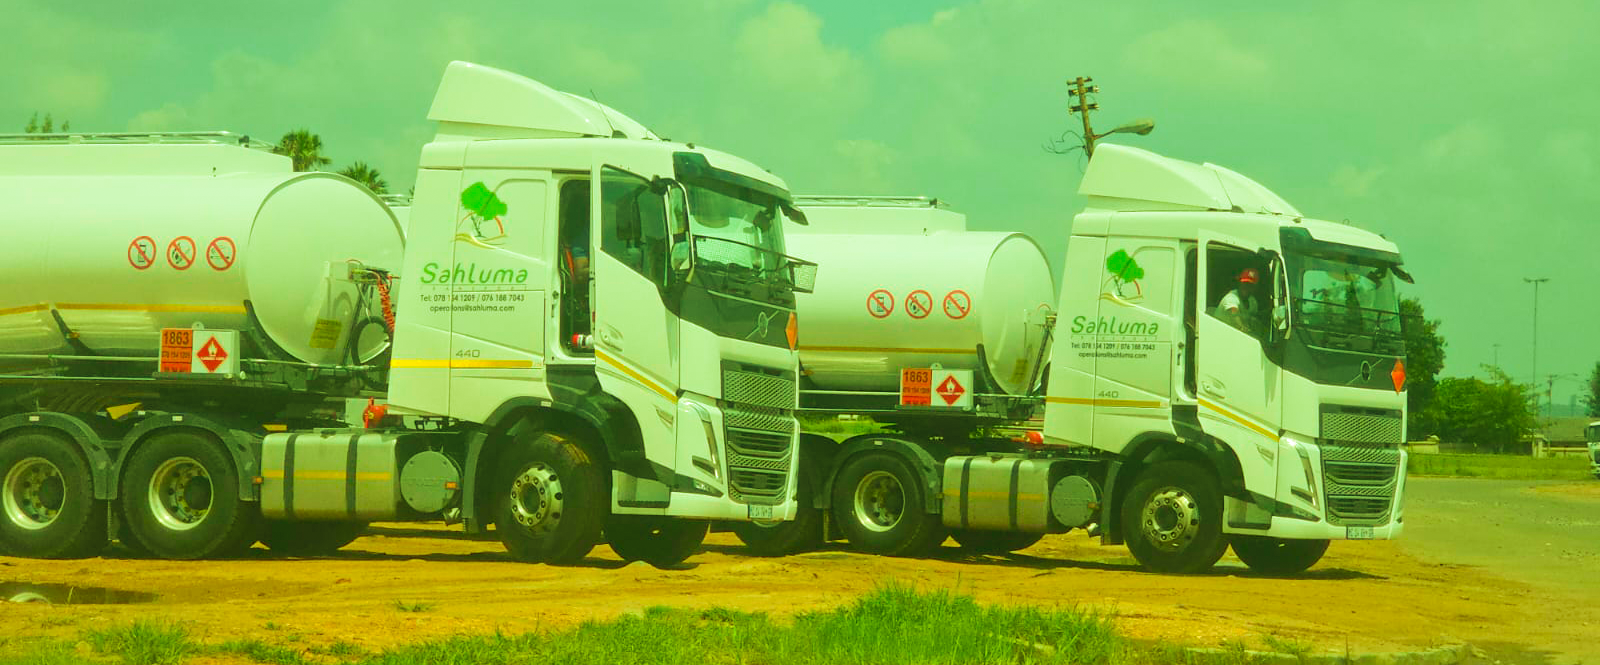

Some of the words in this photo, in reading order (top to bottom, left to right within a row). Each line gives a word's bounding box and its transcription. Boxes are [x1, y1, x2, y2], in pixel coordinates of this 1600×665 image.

[420, 262, 528, 284] Sahluma
[429, 304, 515, 312] operaions@sahluma.com
[1071, 315, 1159, 335] Sahluma
[163, 331, 190, 345] 1863
[455, 349, 480, 358] 440
[903, 371, 929, 383] 1863
[1098, 390, 1119, 398] 440
